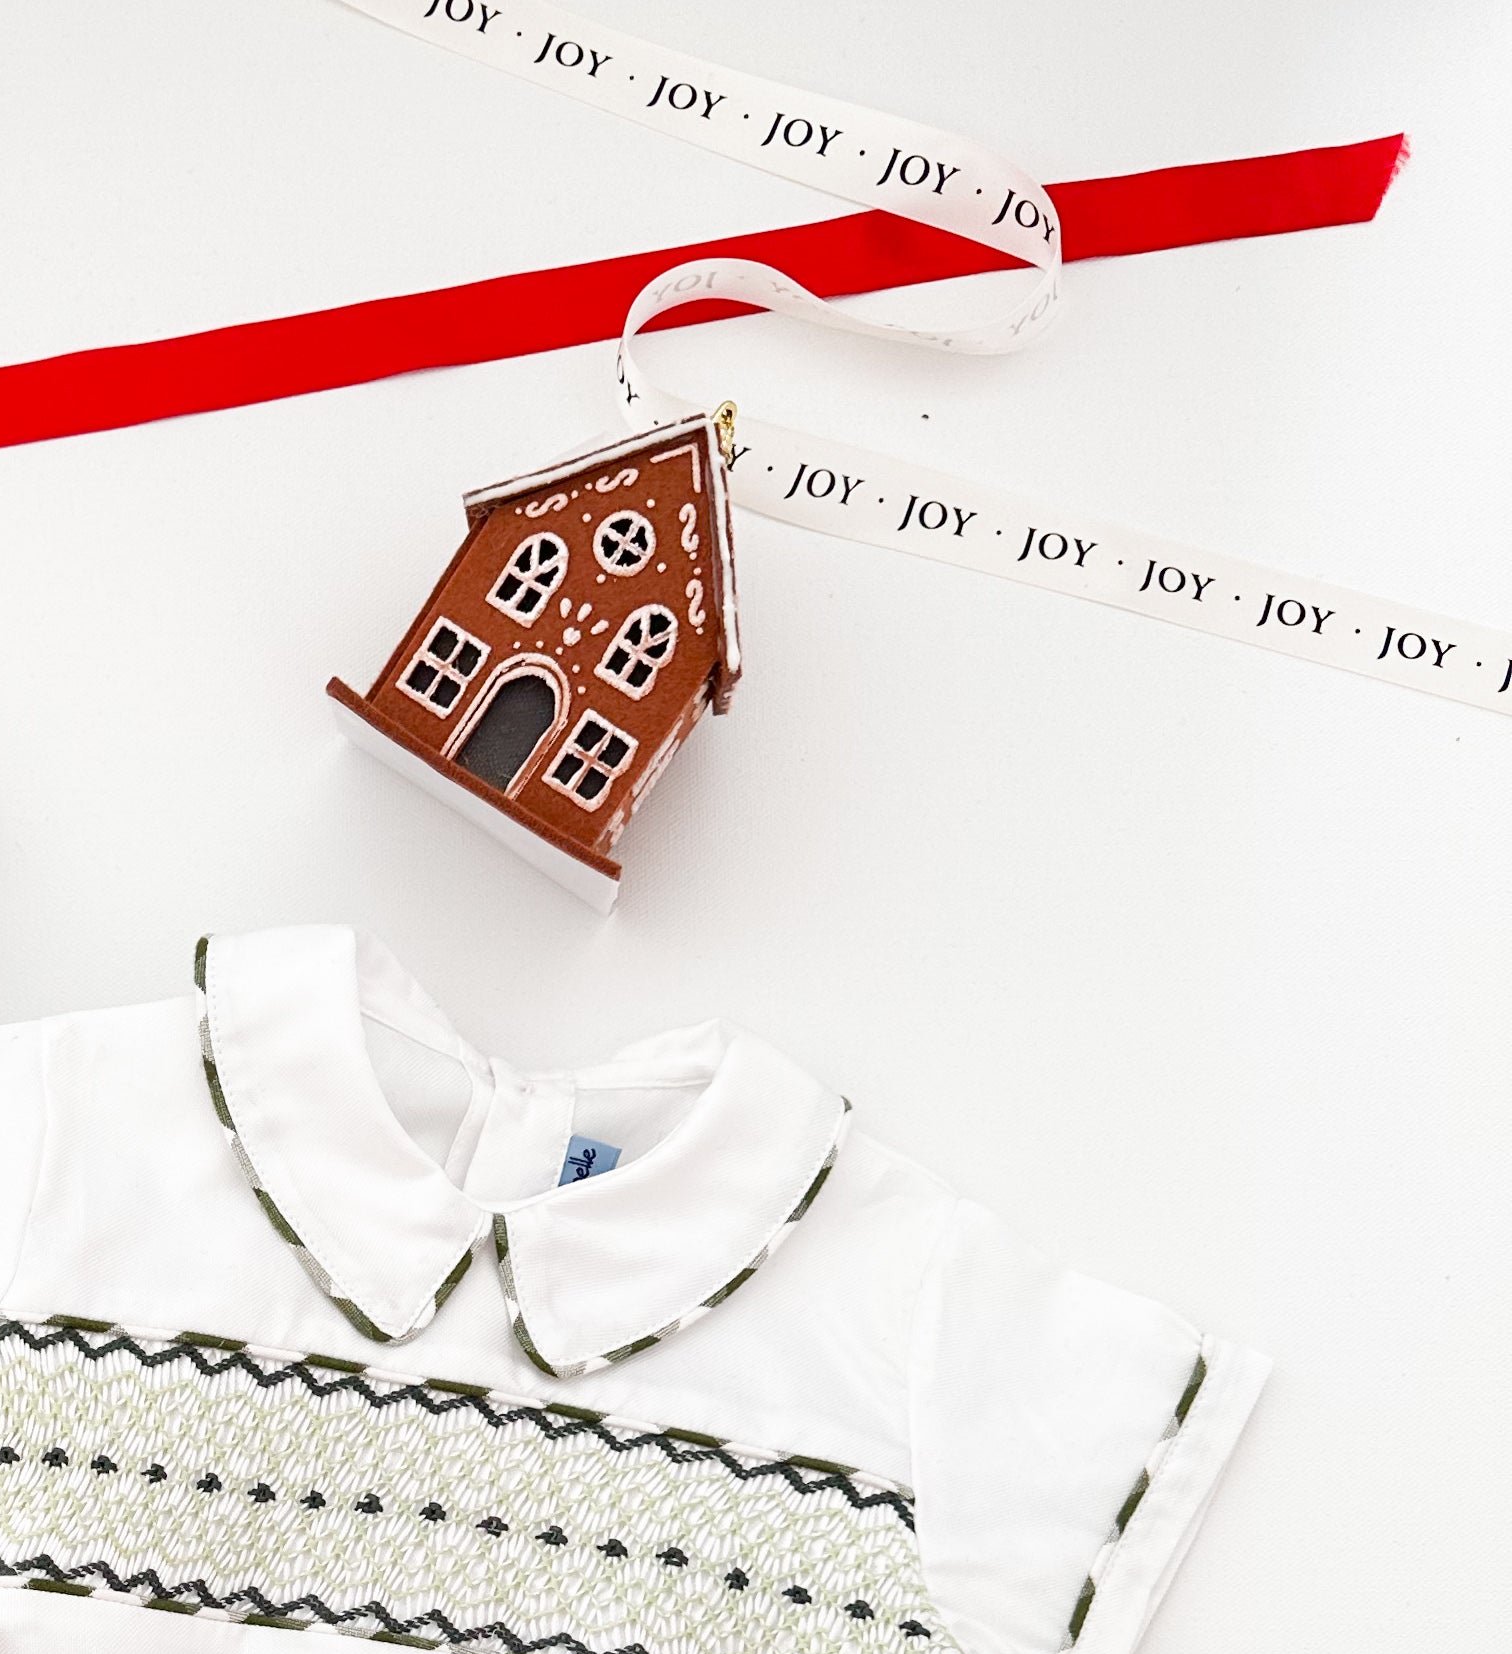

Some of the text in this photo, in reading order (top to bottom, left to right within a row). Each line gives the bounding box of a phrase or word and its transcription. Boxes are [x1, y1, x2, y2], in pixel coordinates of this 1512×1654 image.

[533, 32, 614, 78] JOY
[646, 75, 727, 120] JOY
[760, 112, 843, 157] JOY
[876, 148, 961, 195] JOY
[991, 188, 1056, 244] JOY
[616, 353, 640, 406] OY
[783, 462, 1458, 669] JOY JOY JOY JOY JOY JOY
[568, 1148, 596, 1182] elle
